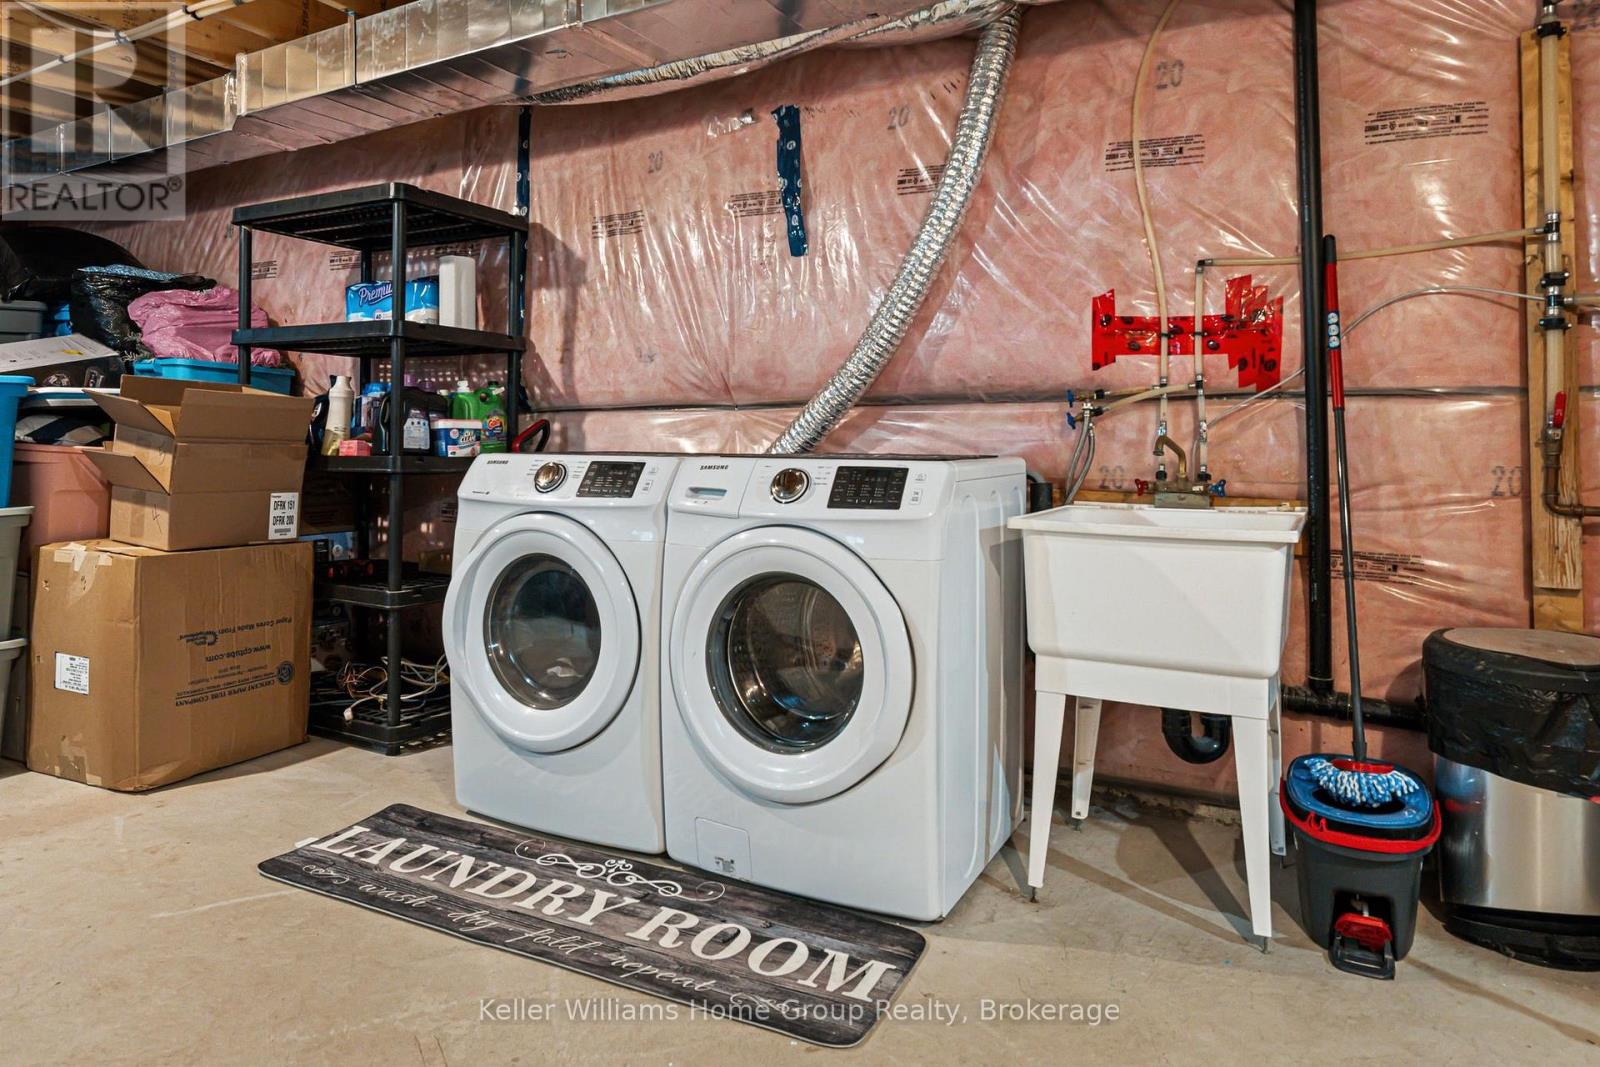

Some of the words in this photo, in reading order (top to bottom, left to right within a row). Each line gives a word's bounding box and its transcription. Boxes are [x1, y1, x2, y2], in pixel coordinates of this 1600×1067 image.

[1156, 60, 1184, 89] 20
[888, 105, 911, 130] 20
[1491, 465, 1523, 497] 20
[308, 825, 640, 926] LAUNDRY
[625, 905, 897, 1003] ROOM
[359, 880, 438, 909] wash
[505, 928, 602, 955] fold
[610, 954, 717, 992] repeat
